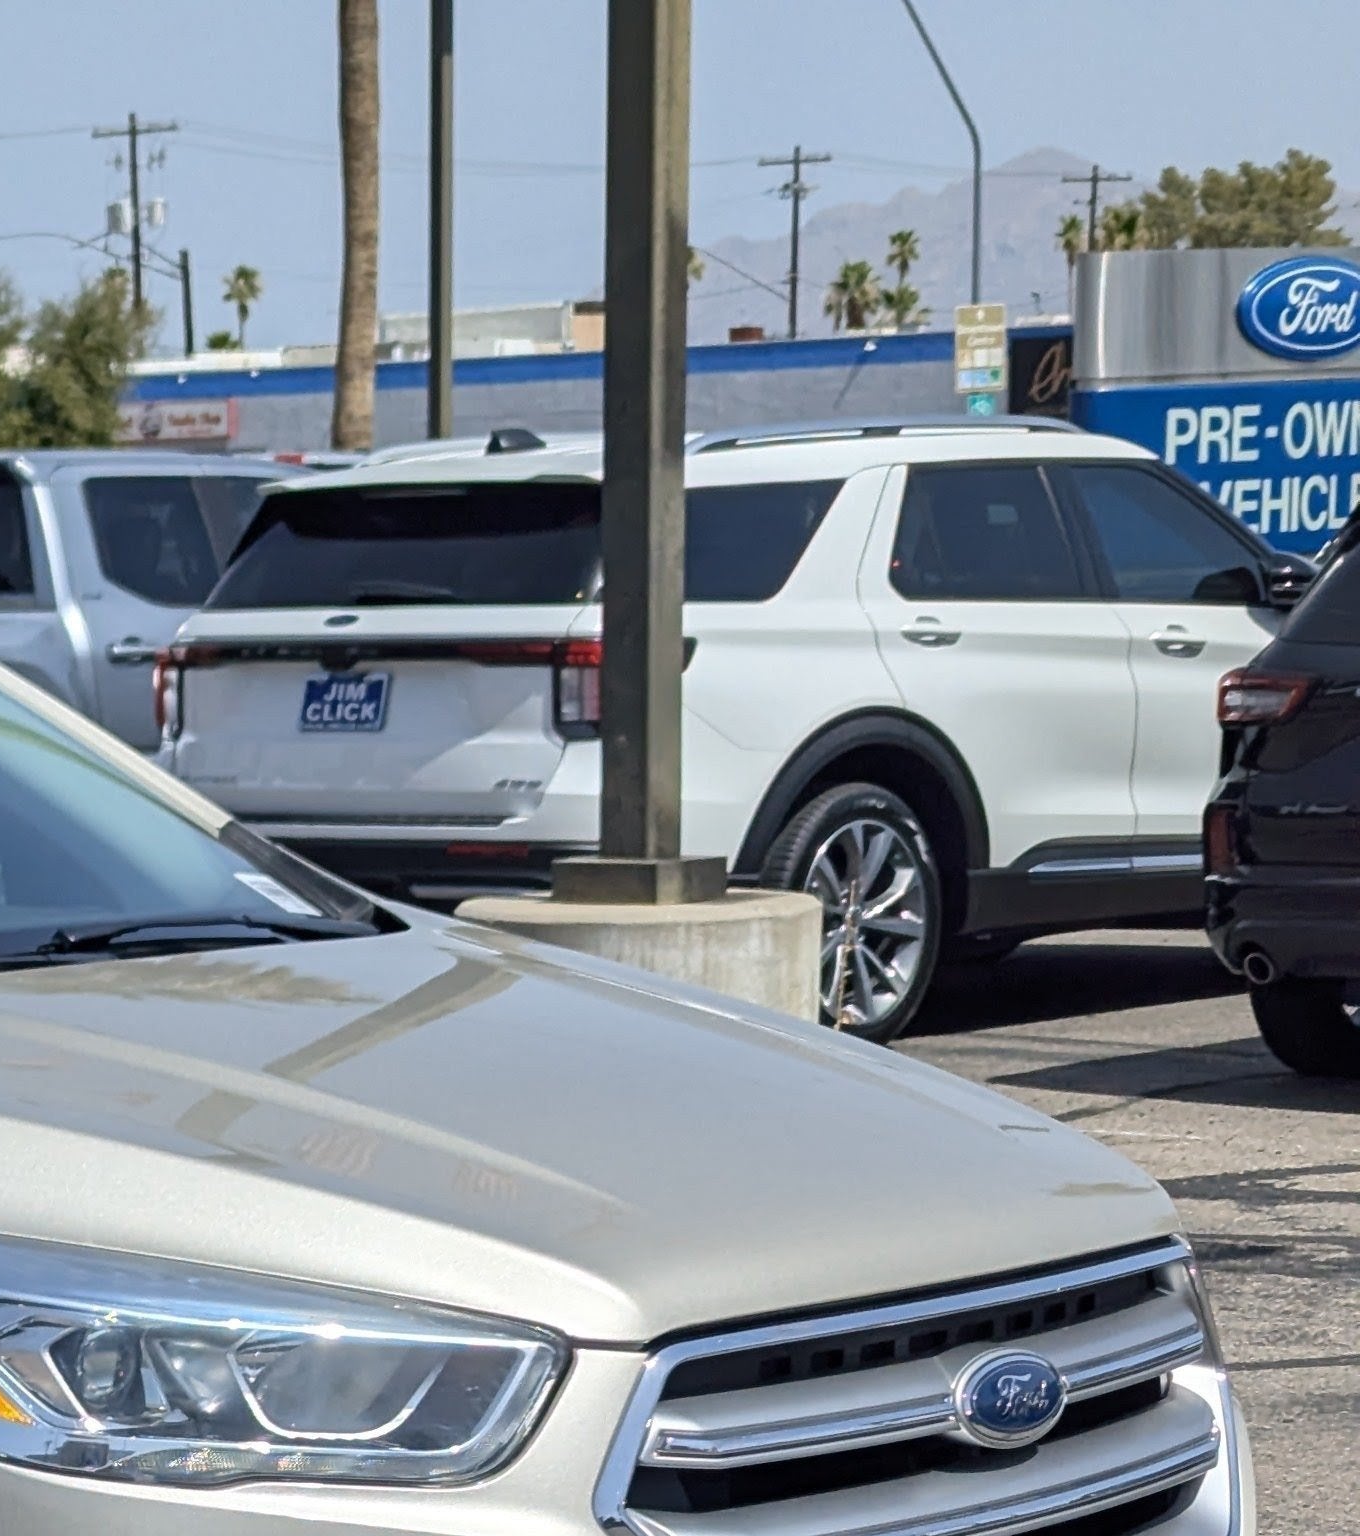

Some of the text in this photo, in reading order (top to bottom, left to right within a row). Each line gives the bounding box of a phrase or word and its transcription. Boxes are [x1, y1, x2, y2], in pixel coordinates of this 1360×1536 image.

[1278, 277, 1359, 336] Ford
[323, 682, 367, 701] JIM
[306, 702, 377, 721] CLICK
